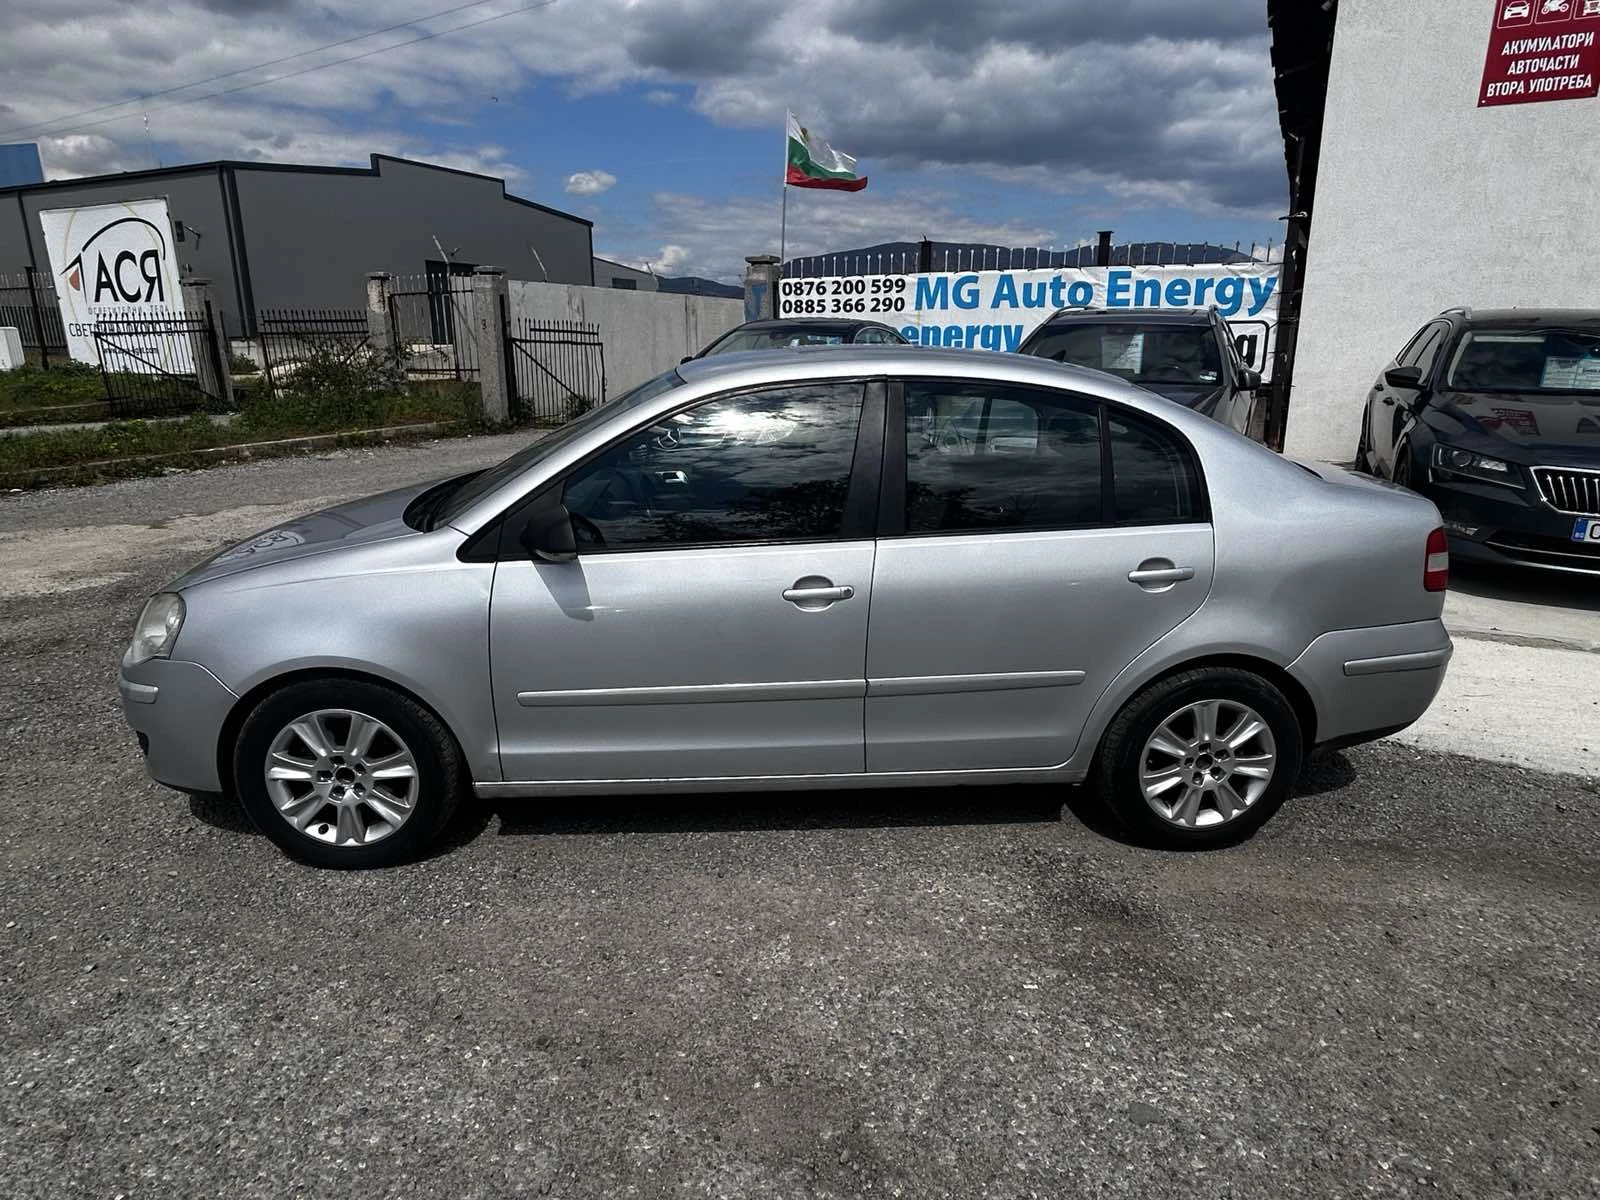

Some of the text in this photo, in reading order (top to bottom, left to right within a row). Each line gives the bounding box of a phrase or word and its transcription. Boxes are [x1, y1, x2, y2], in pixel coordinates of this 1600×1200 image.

[1501, 32, 1595, 56] АКУМУЛАТОРИ
[1507, 54, 1580, 75] АВТОЧАСТИ
[1486, 74, 1592, 97] ВТОРА УПОТРЕБА
[94, 249, 165, 303] АСЯ
[782, 278, 906, 297] 0876 200 599
[782, 296, 905, 314] 0885 366 290
[915, 270, 1279, 317] MG Auto Energy
